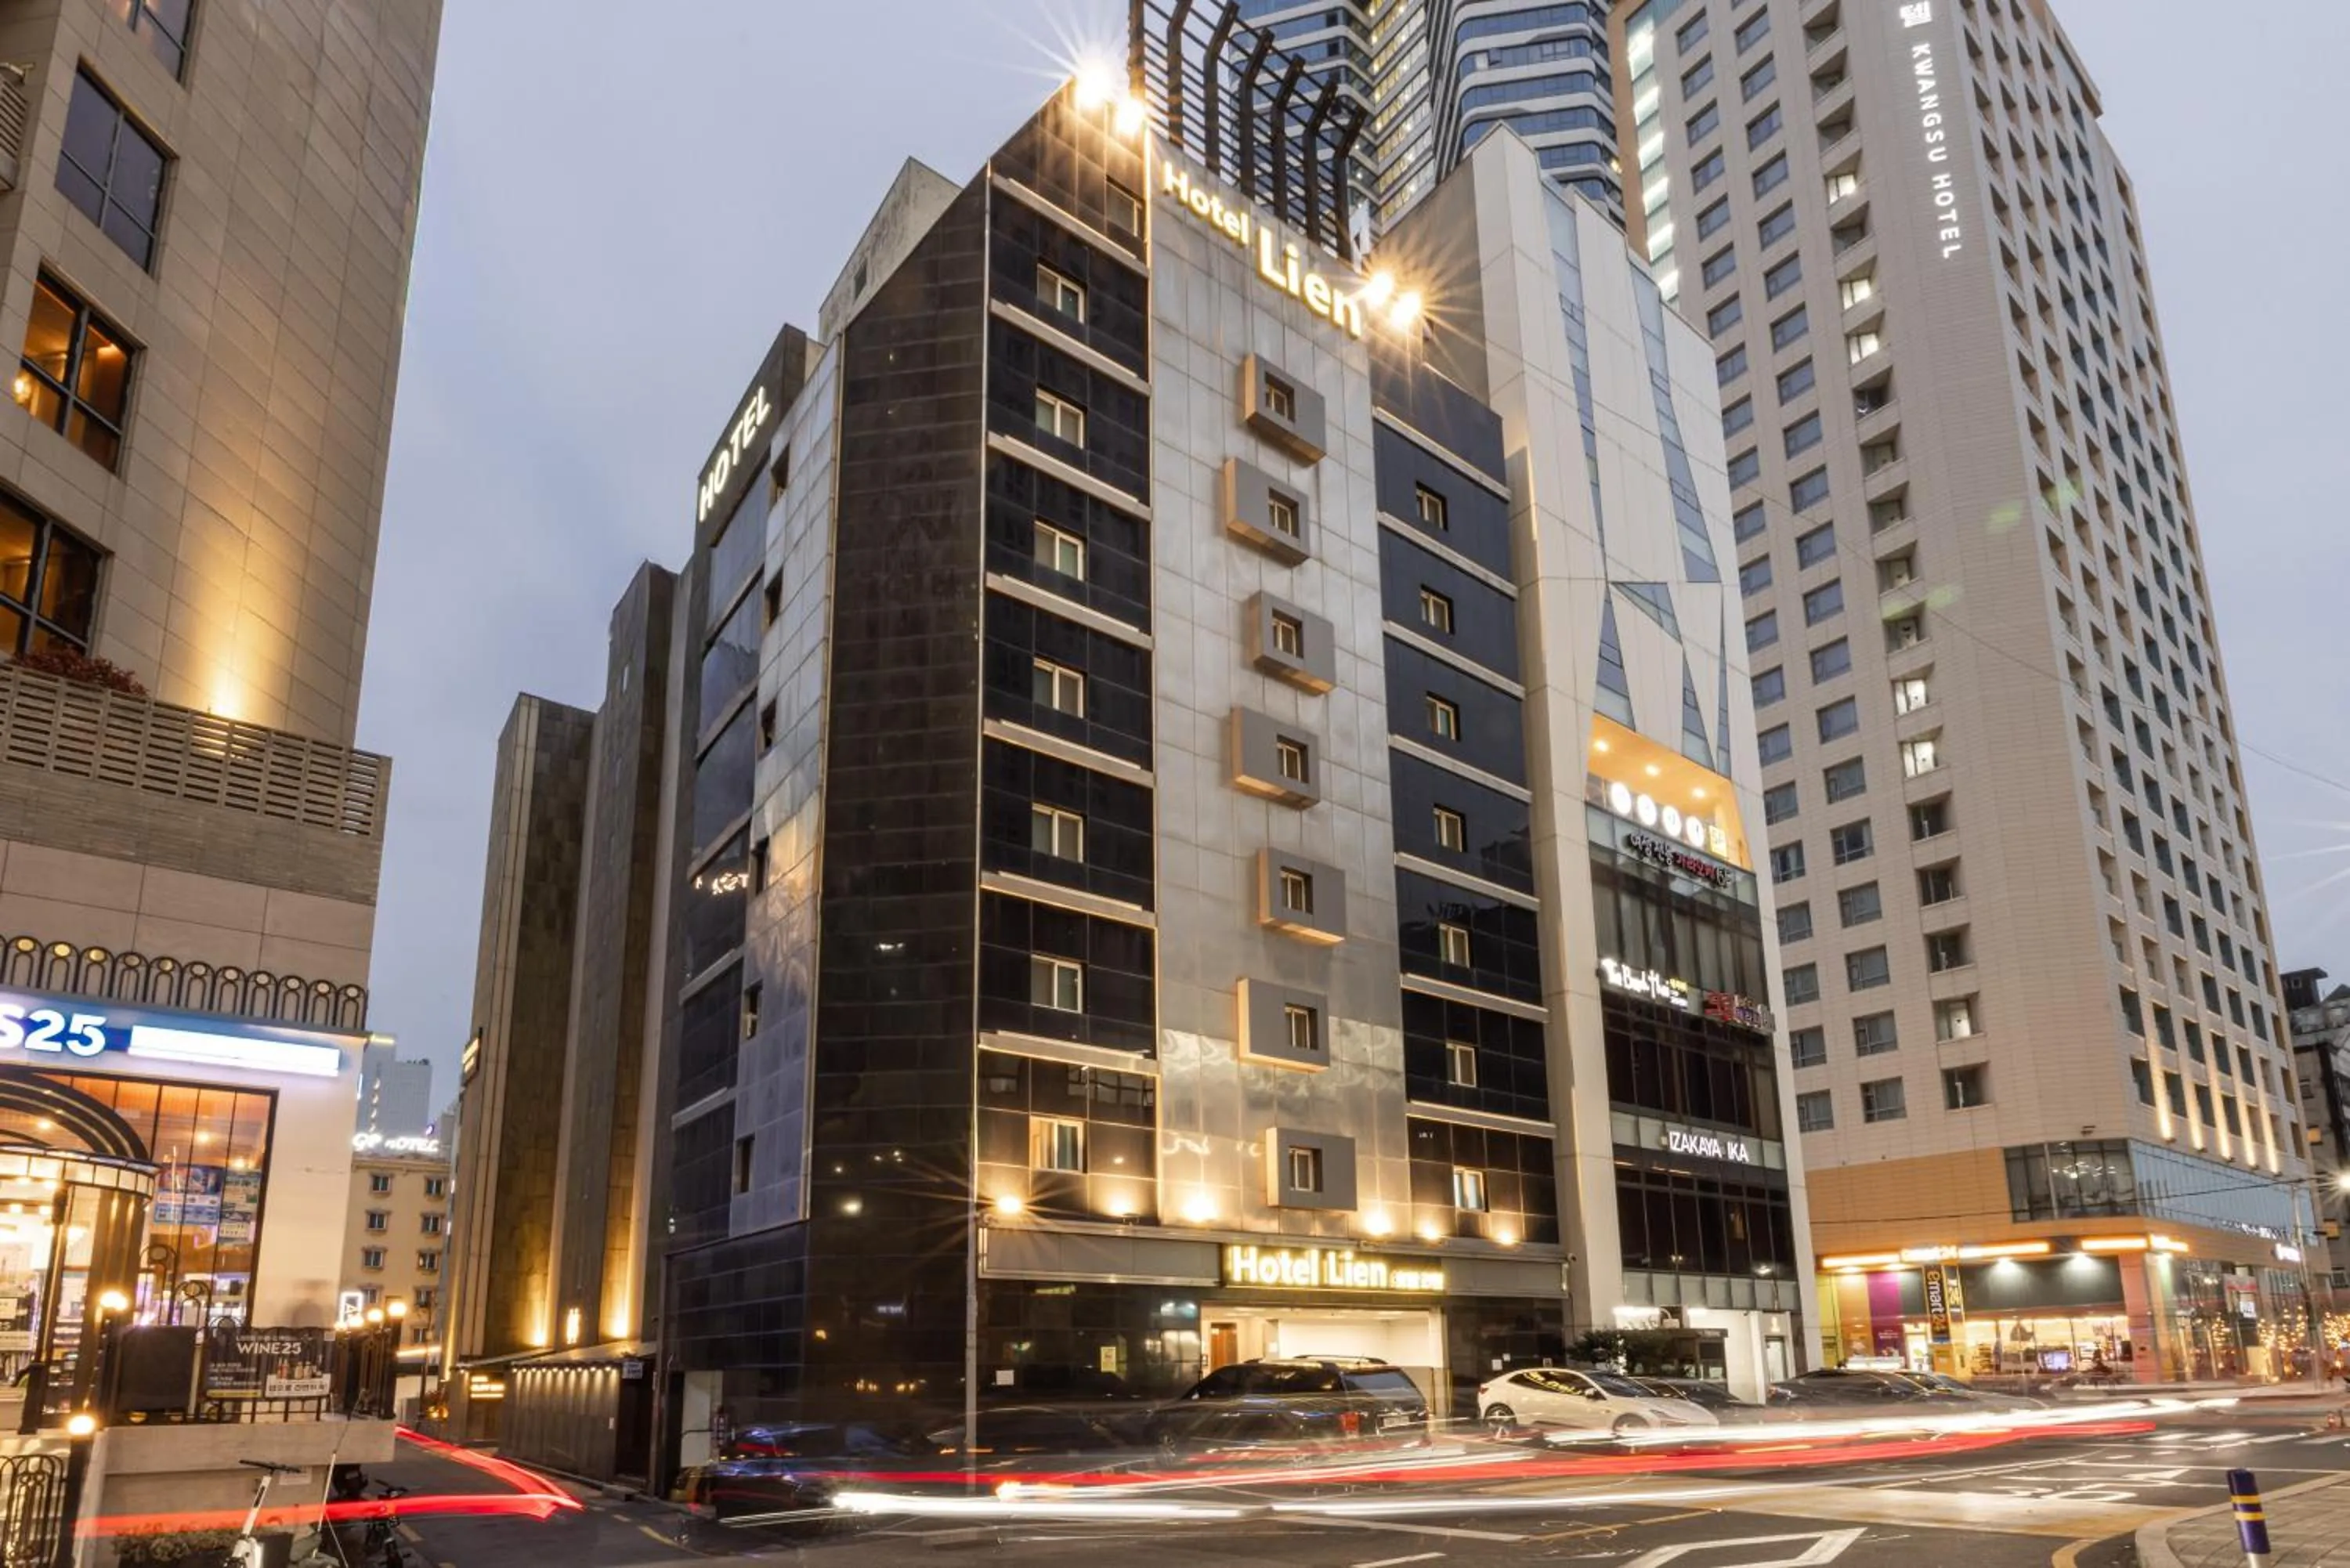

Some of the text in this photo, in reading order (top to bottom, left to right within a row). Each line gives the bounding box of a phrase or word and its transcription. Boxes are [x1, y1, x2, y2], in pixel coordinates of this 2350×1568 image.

[1911, 43, 1947, 162] KWANGSU
[1932, 173, 1961, 259] HOTEL
[1162, 161, 1361, 338] Hotel Lien
[699, 386, 772, 522] HOTEL
[1669, 1131, 1723, 1158] IZAKAYA
[1231, 1245, 1321, 1286] Hotel
[1325, 1250, 1388, 1288] Lien
[1926, 1270, 1947, 1332] emart24
[237, 1342, 302, 1355] WINE25
